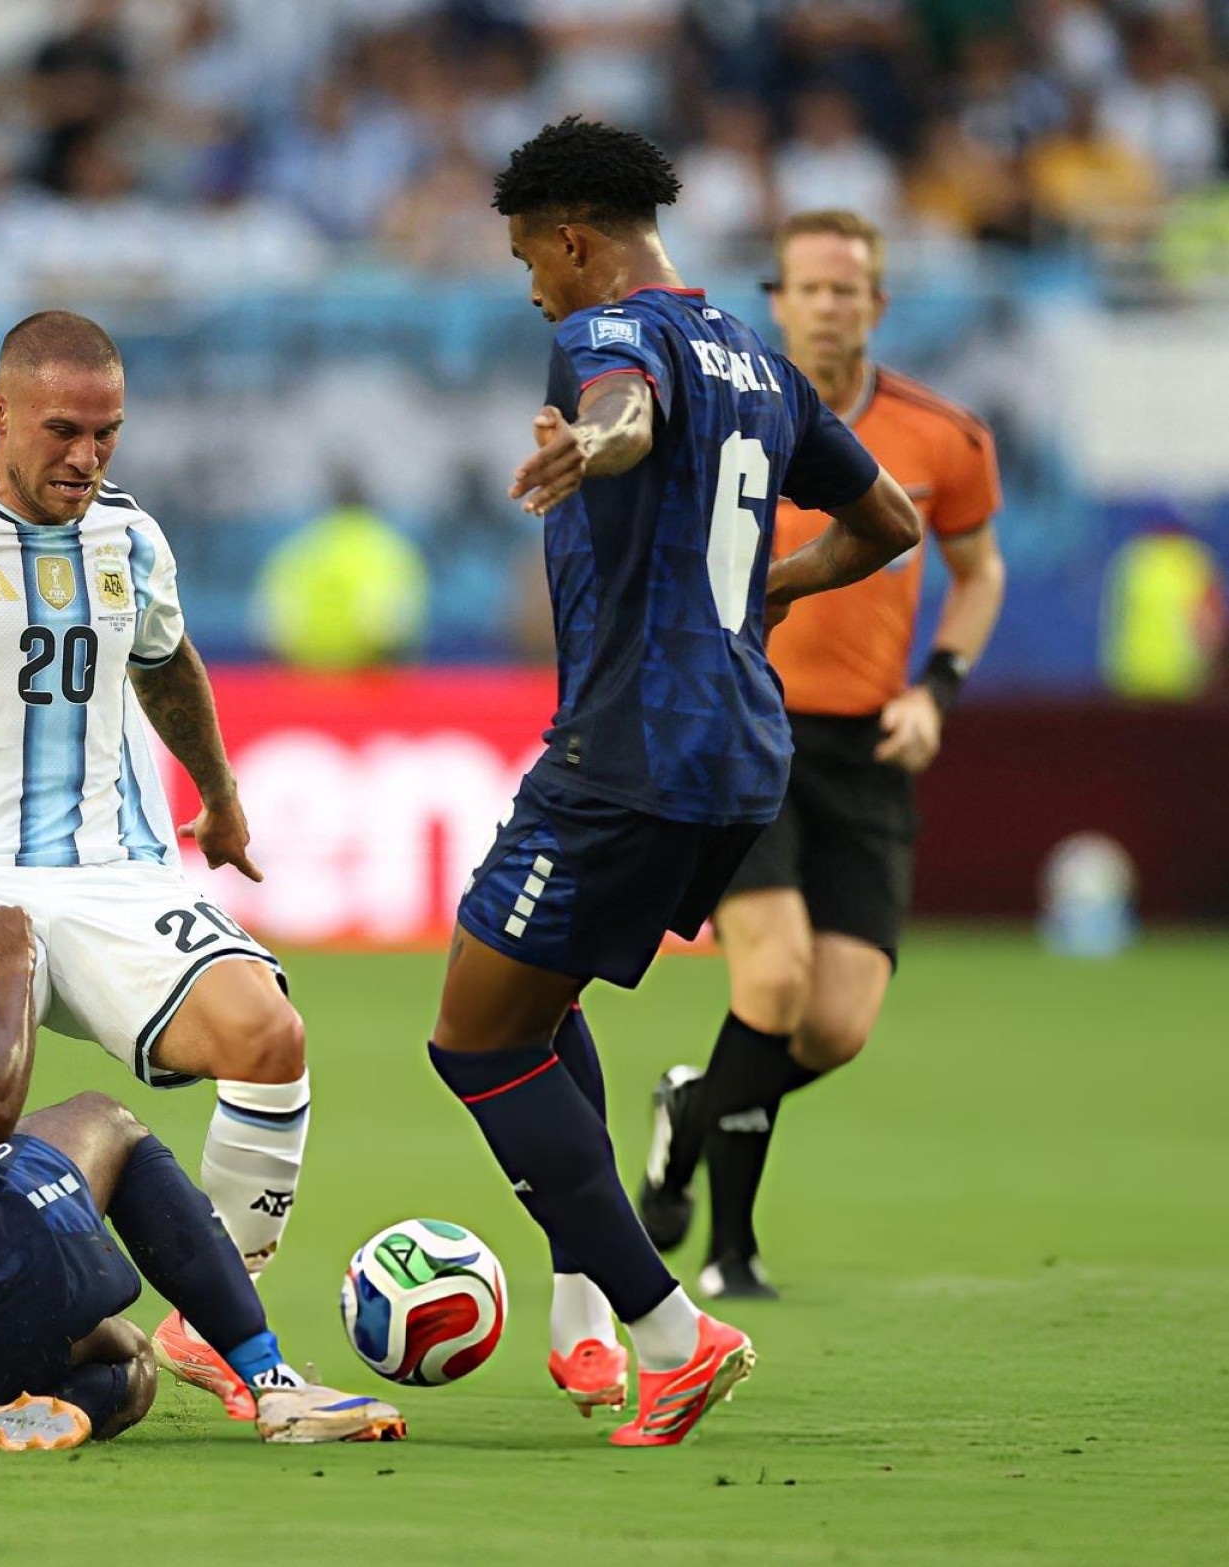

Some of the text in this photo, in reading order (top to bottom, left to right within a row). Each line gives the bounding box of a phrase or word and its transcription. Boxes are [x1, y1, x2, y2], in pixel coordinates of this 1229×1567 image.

[706, 430, 770, 635] 6
[18, 625, 98, 705] 20
[155, 902, 251, 953] 20
